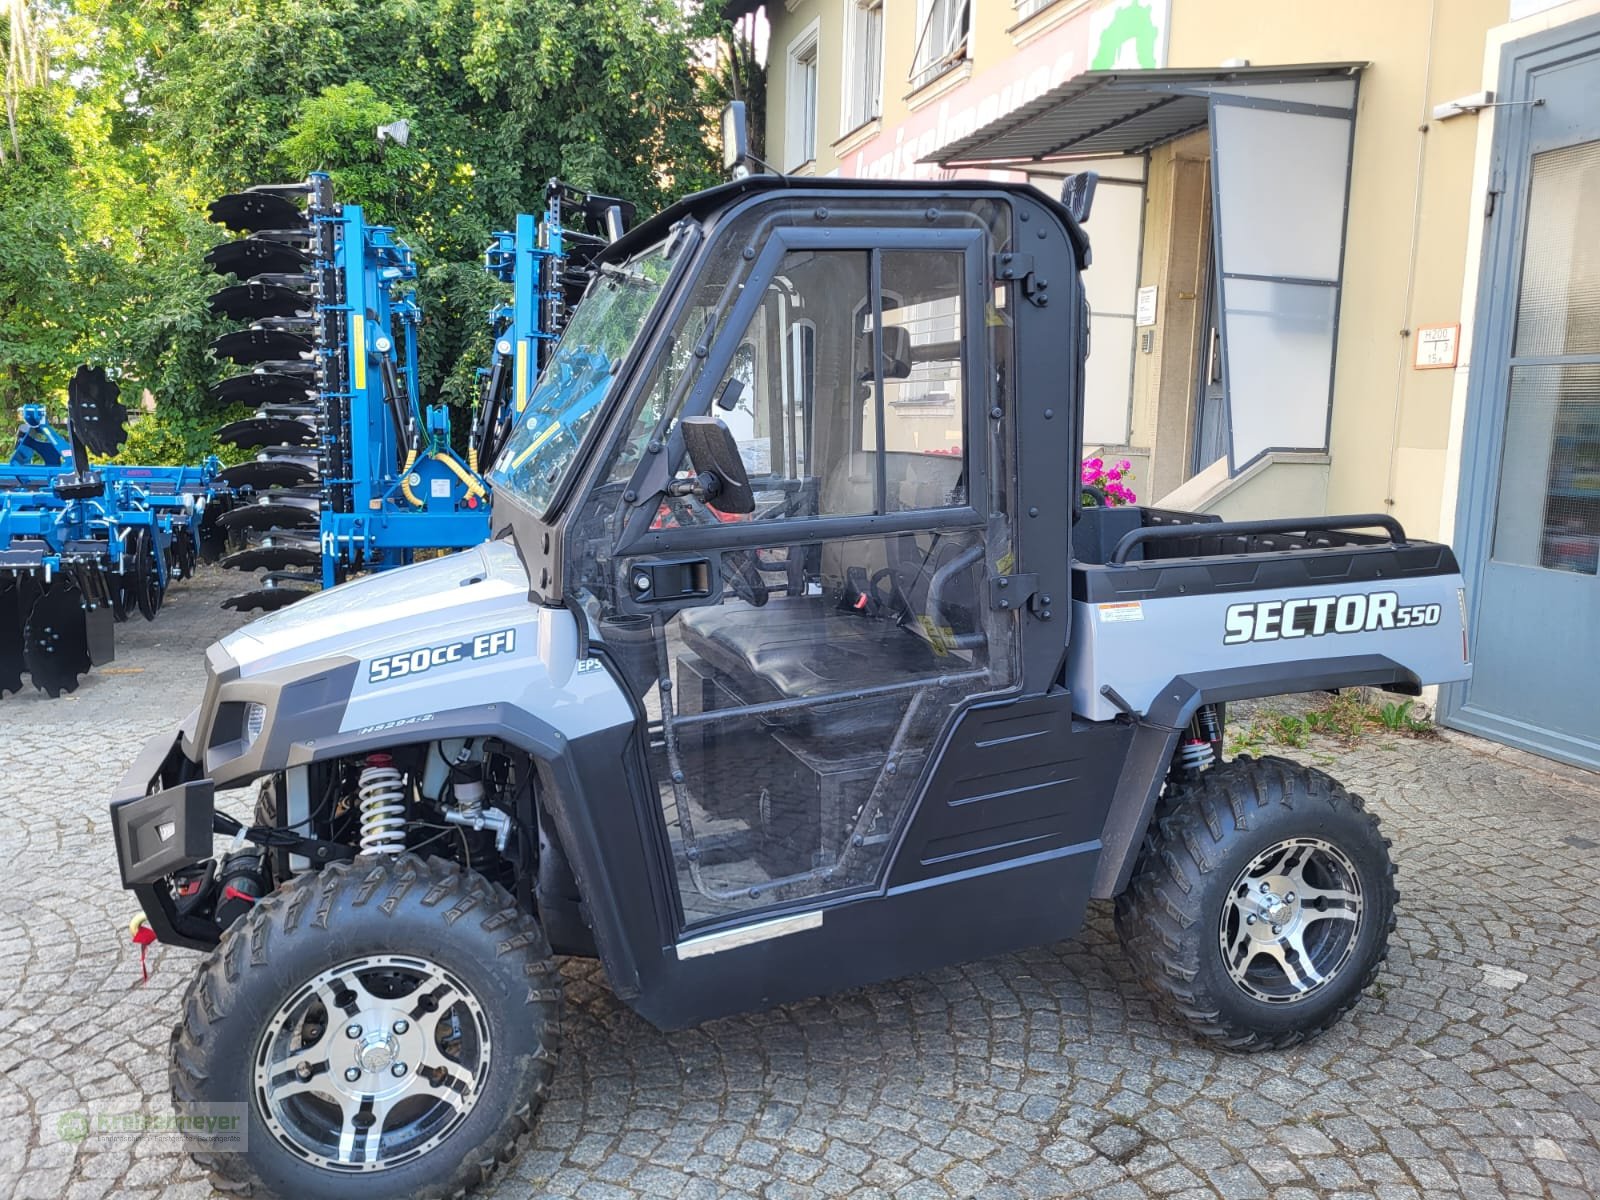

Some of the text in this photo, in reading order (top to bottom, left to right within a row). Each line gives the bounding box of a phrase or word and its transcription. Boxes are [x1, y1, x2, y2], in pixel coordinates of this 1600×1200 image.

[1224, 592, 1440, 645] SECTOR 550
[369, 628, 516, 683] 550cc EFI
[578, 658, 601, 672] EPS
